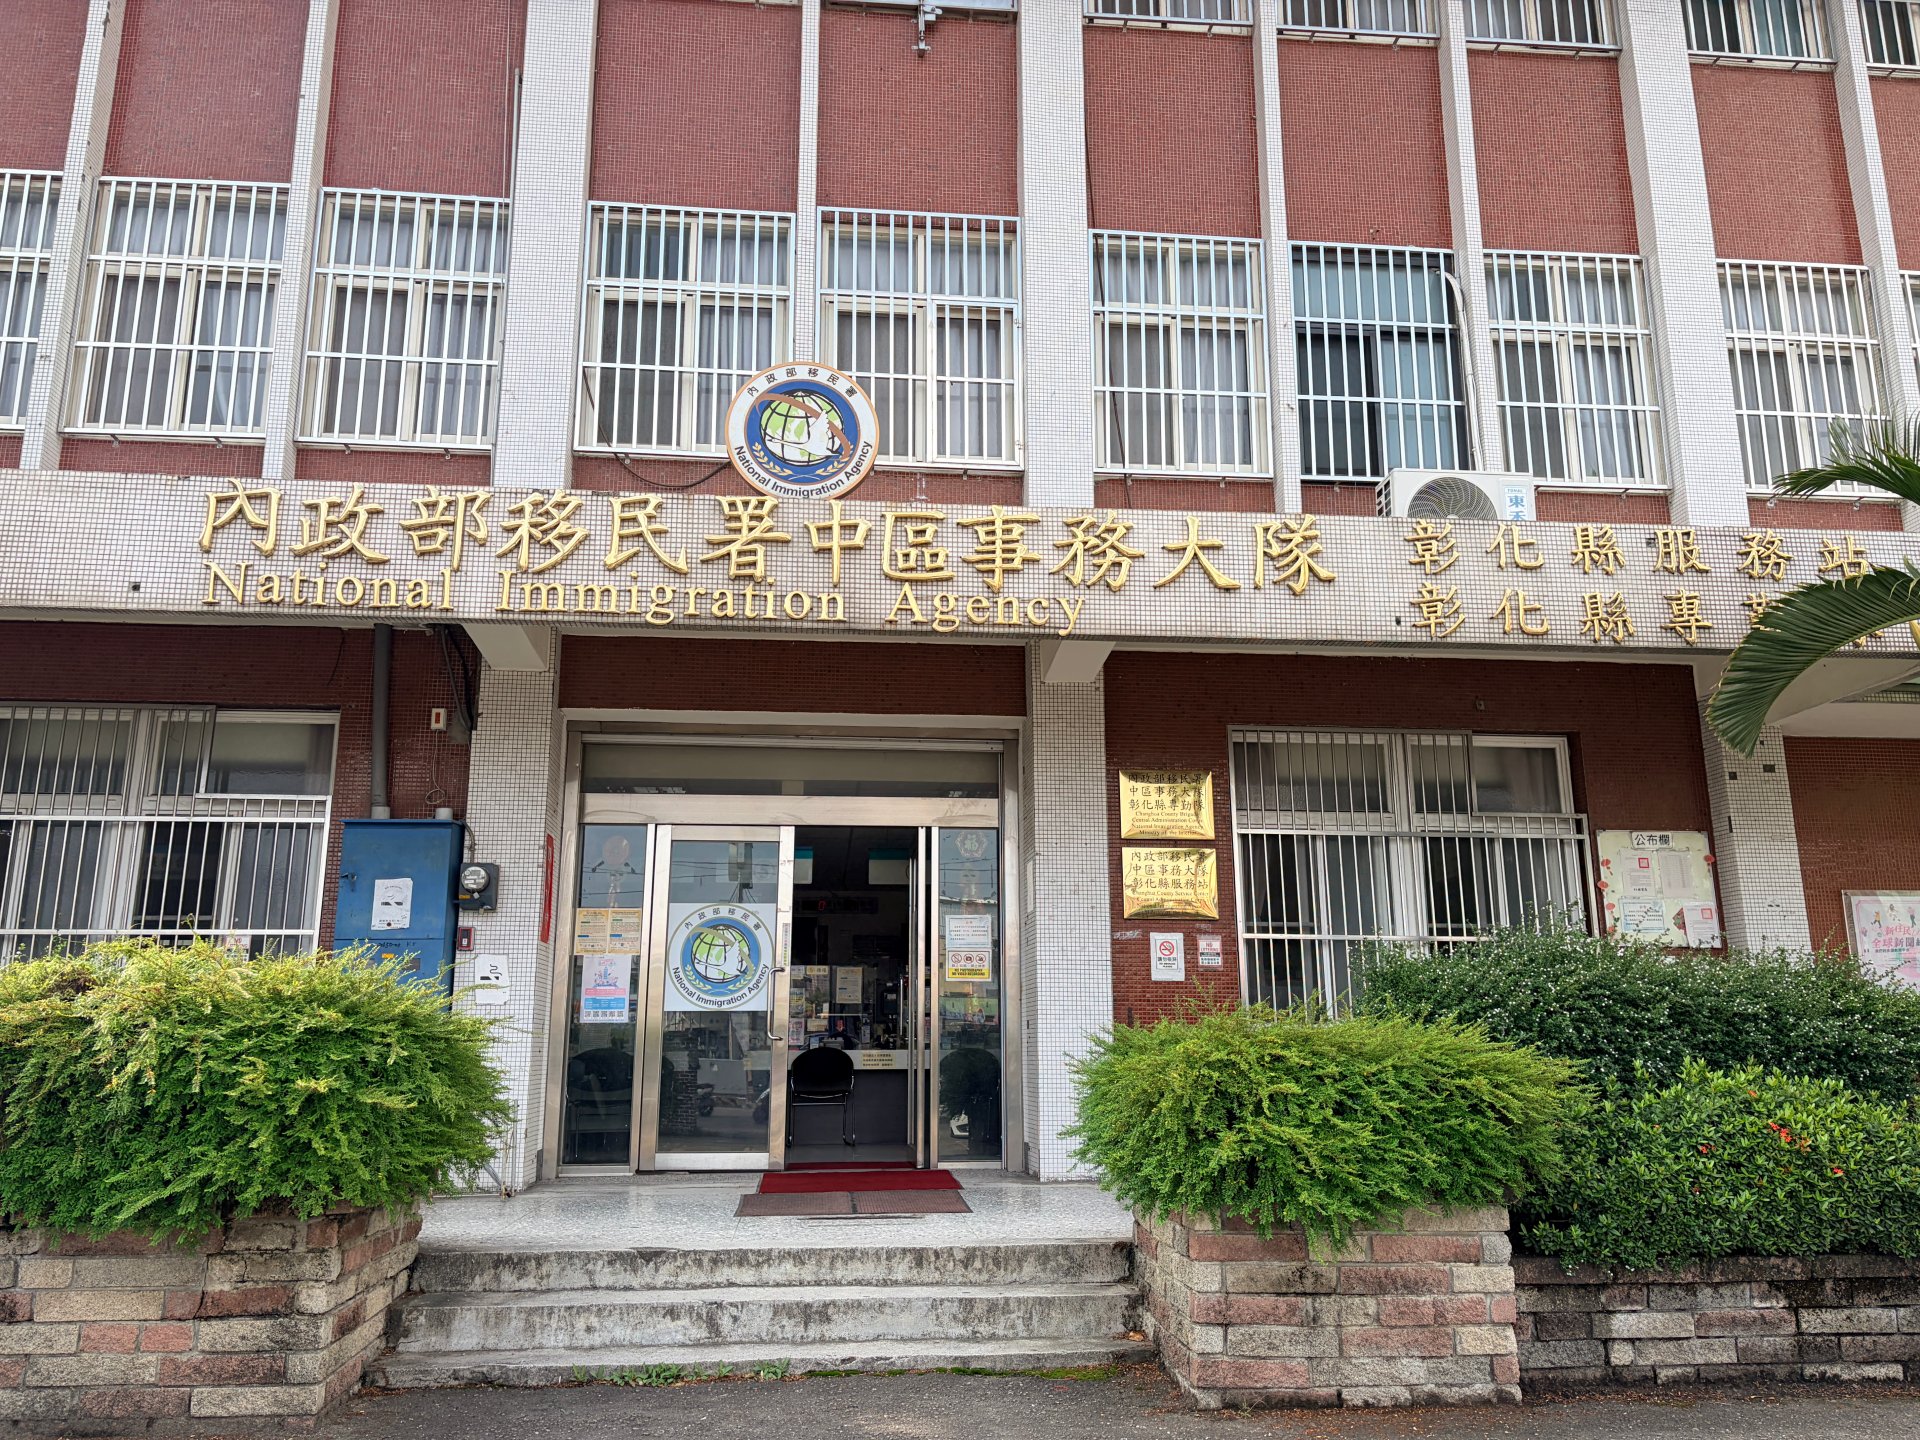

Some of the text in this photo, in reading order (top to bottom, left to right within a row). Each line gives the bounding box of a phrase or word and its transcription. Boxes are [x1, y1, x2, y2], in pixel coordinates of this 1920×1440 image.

[747, 367, 857, 397] 內政部移民署
[735, 441, 873, 499] National Immigration Agency
[198, 478, 1337, 596] 內政部移民署中區事務大隊
[1404, 518, 1869, 581] 彰化縣服務站
[201, 559, 1086, 637] National Immigration Agency
[1128, 773, 1204, 784] 內政部移民署
[1129, 785, 1204, 797] 中區事務大隊
[1129, 799, 1205, 810] 彰化縣專勤隊
[1634, 833, 1670, 846] 公布欄
[1131, 850, 1206, 862] 內政部移民署
[1132, 863, 1208, 876] 中區事務大隊
[1131, 877, 1209, 890] 彰化縣服務站
[684, 907, 762, 932] 內政部移民署
[672, 963, 770, 1008] National Immigration Agency
